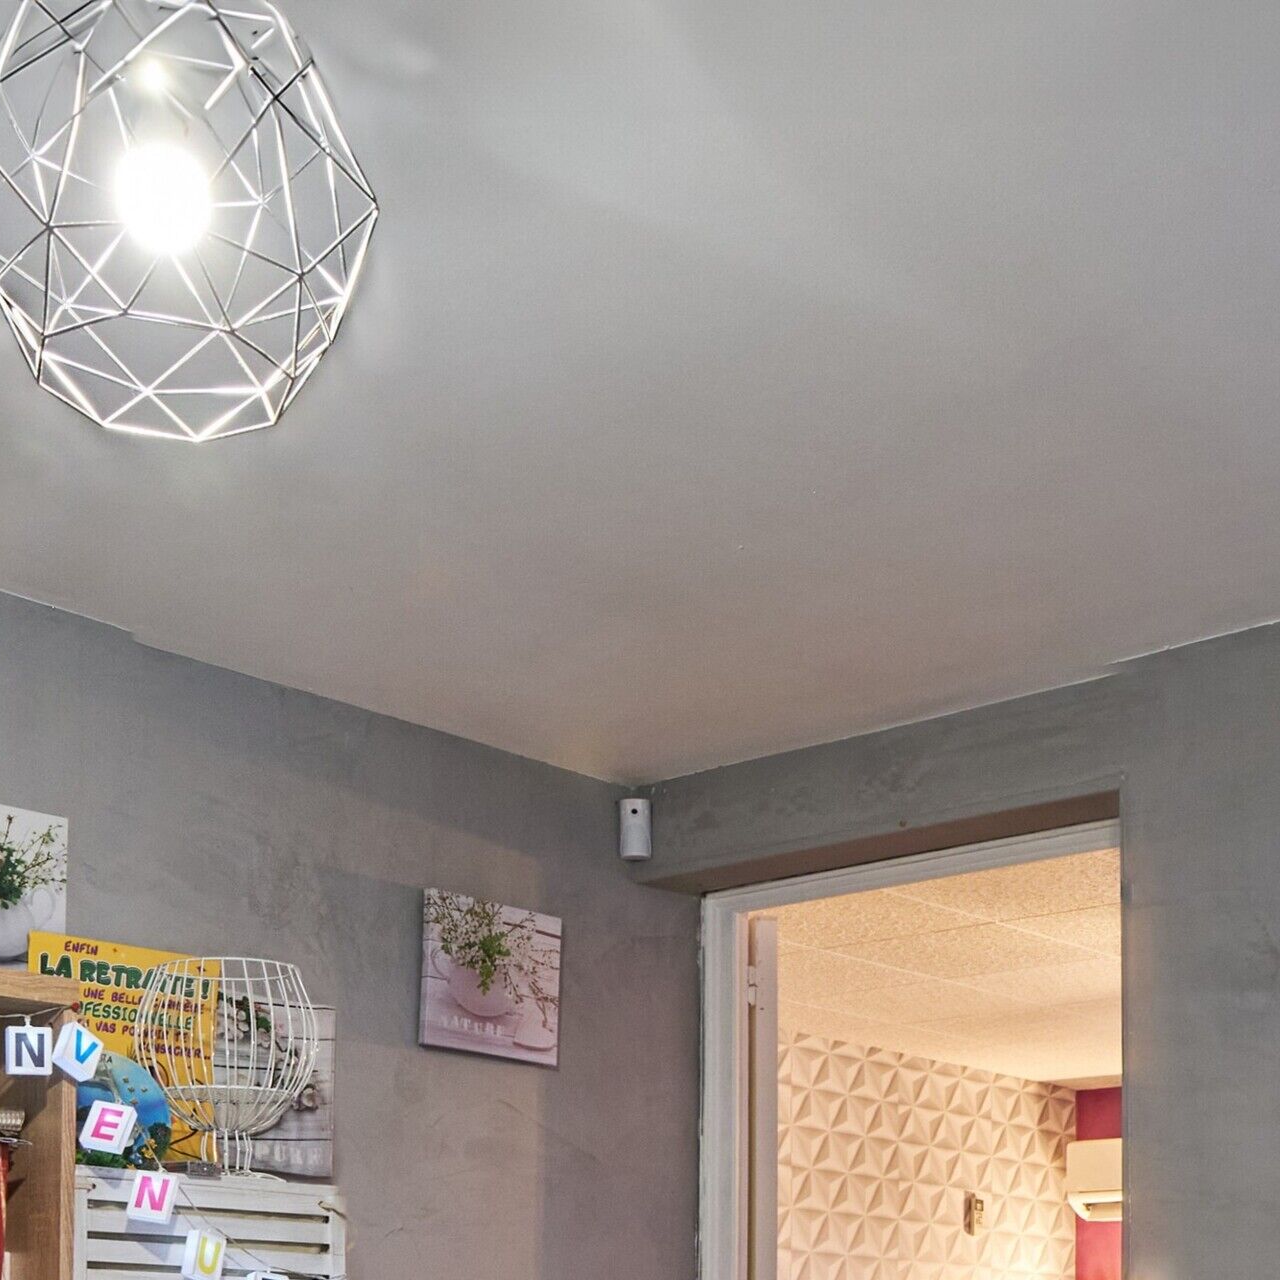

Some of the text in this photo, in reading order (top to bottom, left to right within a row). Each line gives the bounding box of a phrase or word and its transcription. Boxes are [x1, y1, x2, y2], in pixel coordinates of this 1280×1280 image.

[64, 941, 98, 956] ENFIN
[40, 952, 72, 978] LA
[83, 987, 104, 1000] UNE
[95, 1021, 116, 1033] VAS
